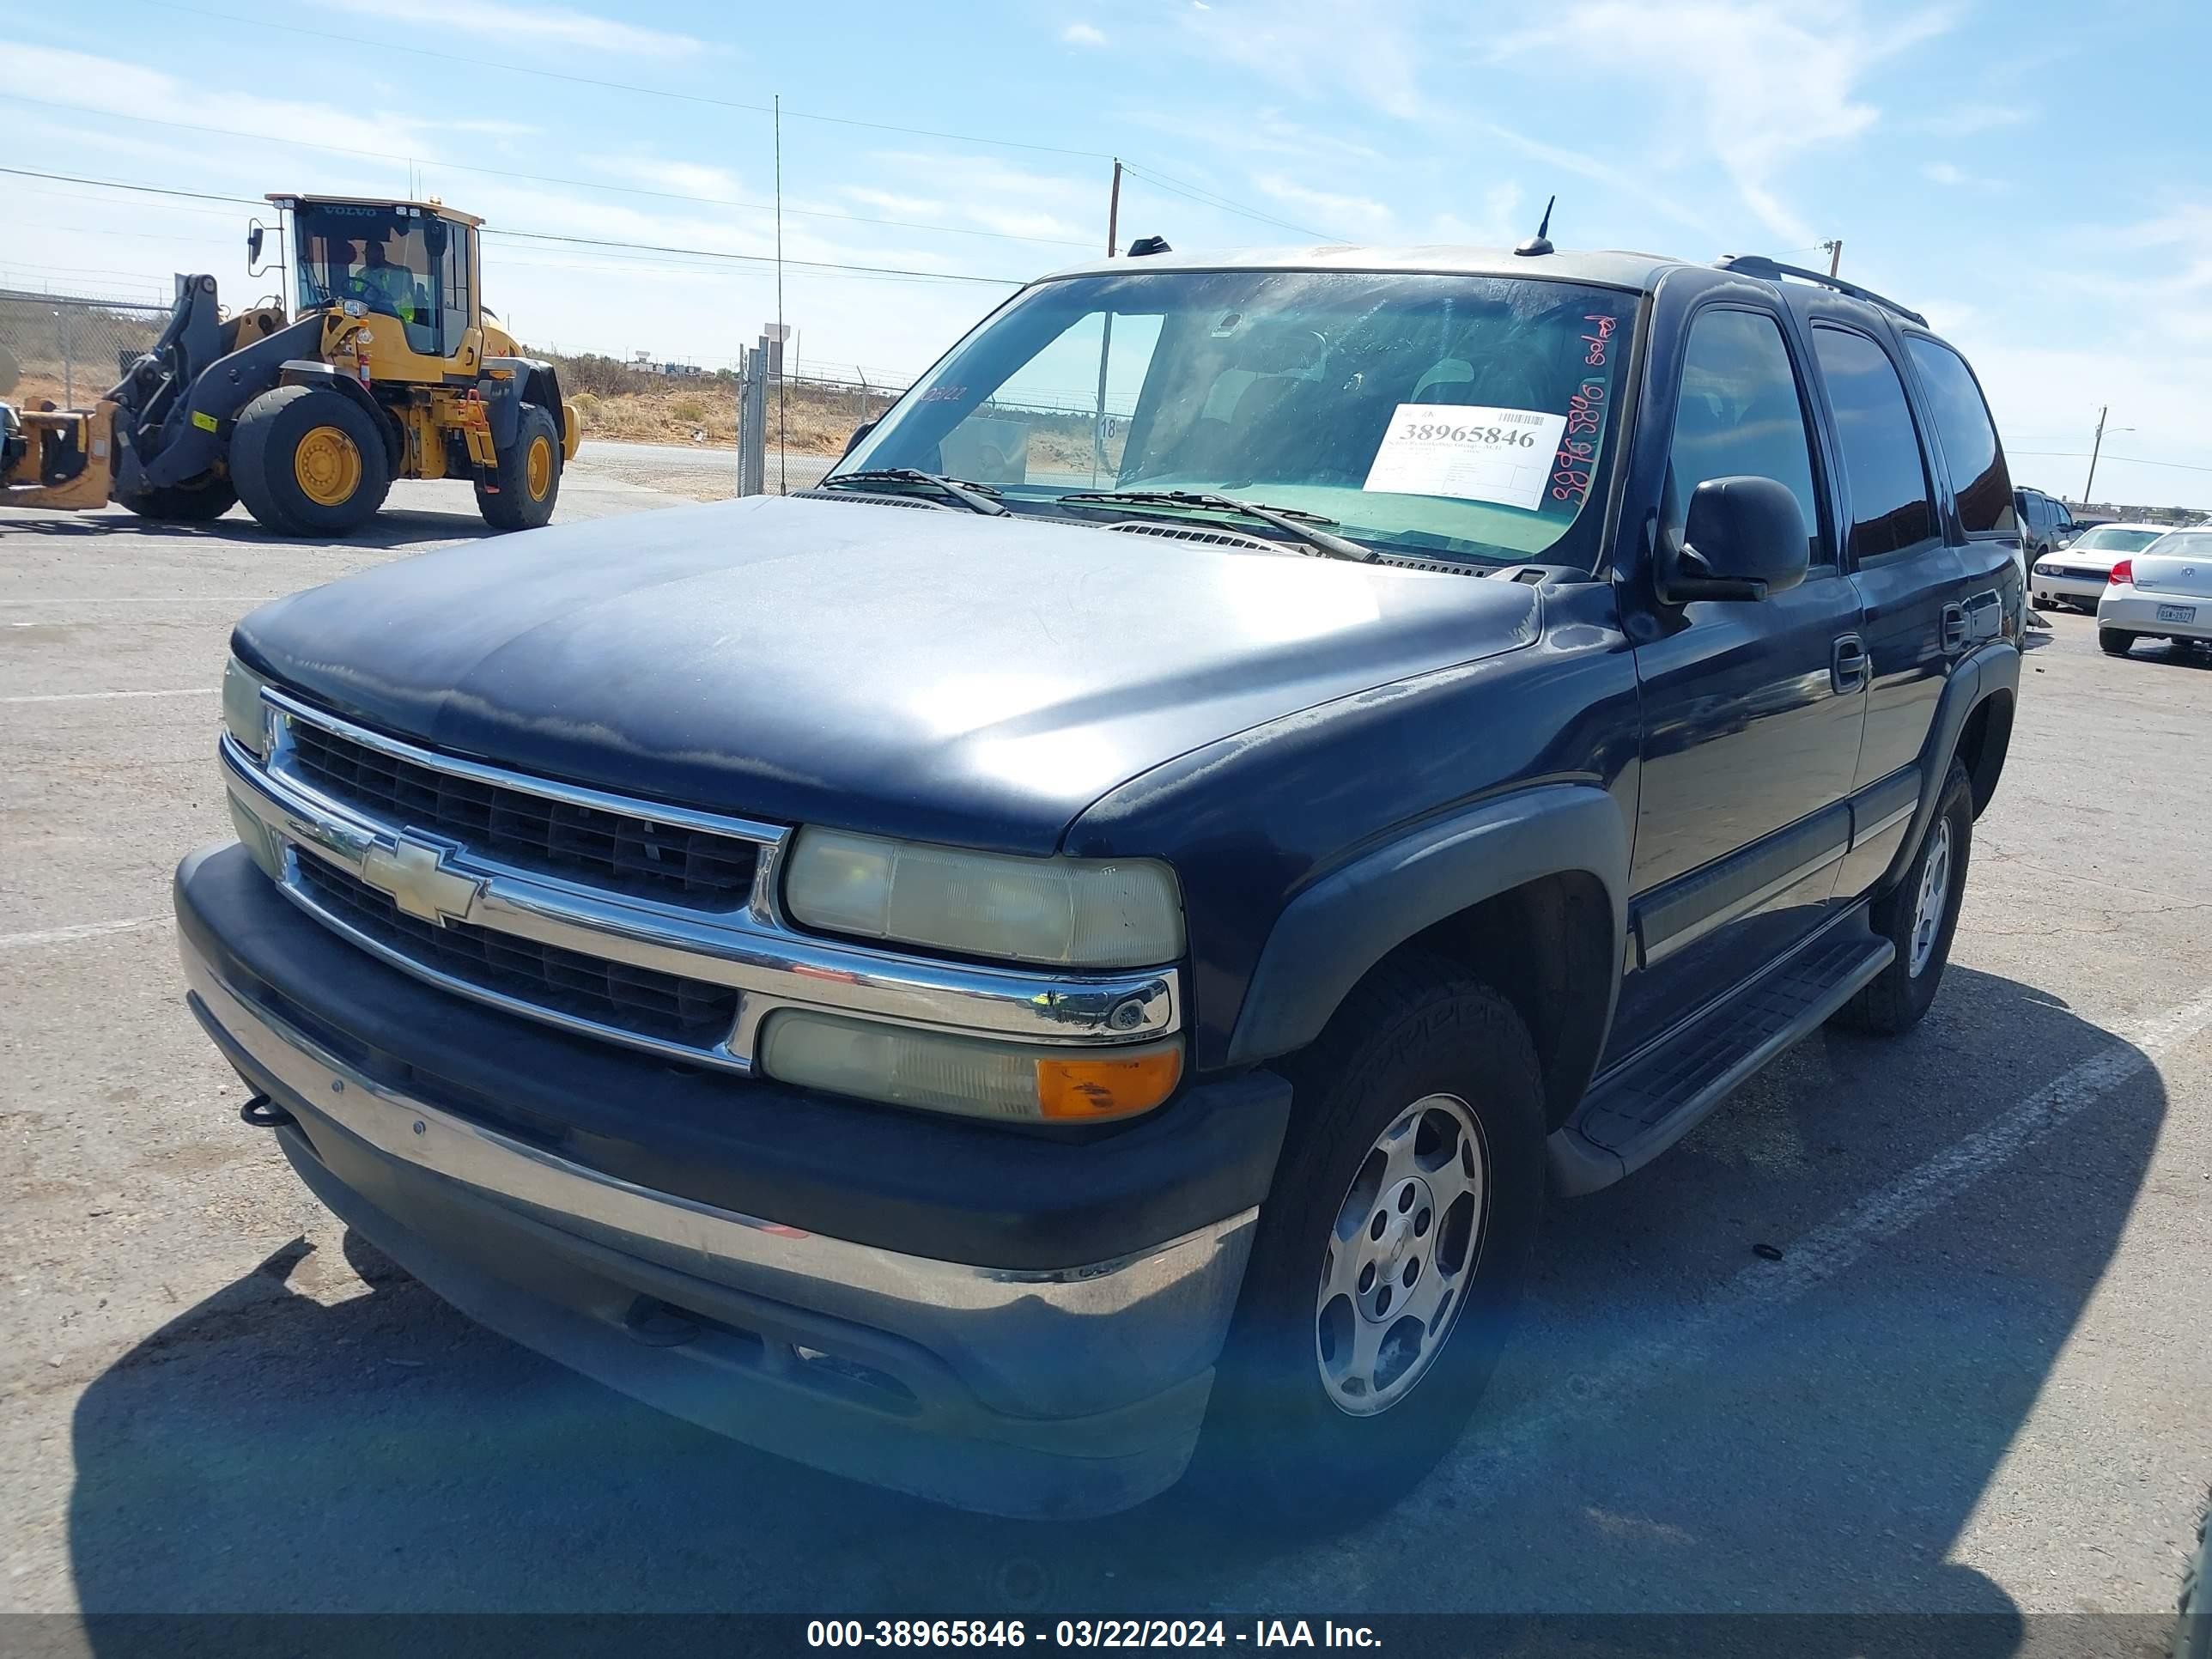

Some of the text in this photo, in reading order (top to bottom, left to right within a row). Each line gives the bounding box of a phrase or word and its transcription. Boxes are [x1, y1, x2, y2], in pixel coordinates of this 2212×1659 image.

[323, 205, 377, 217] VOLVO
[1101, 418, 1115, 439] 18
[1399, 424, 1538, 447] 38965846
[1553, 385, 1604, 506] 38965846
